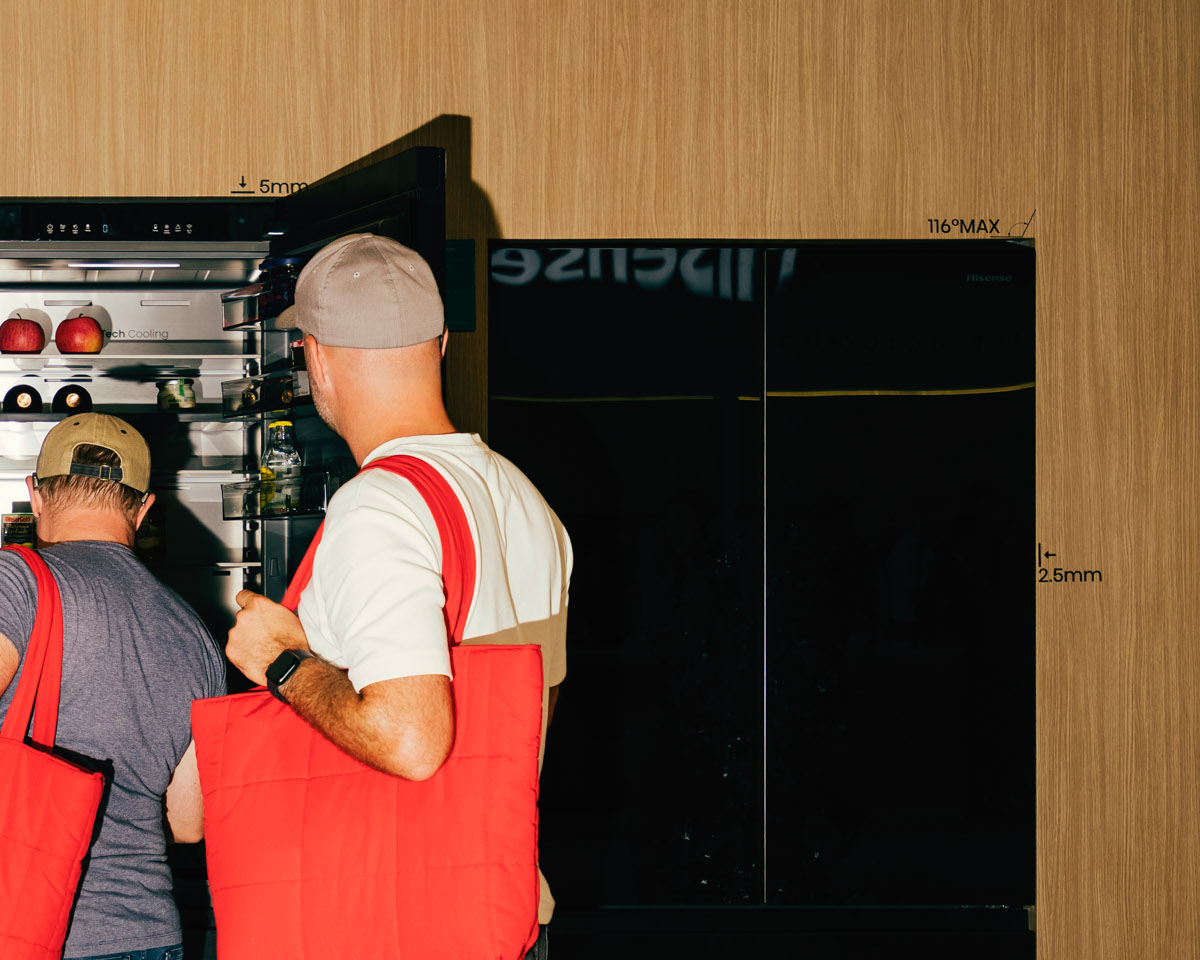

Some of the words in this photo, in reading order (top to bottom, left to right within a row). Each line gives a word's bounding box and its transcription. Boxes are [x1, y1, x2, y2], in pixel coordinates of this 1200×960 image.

[260, 180, 309, 194] 5mm
[966, 274, 1013, 282] Hisense
[128, 330, 168, 340] Cooling
[1038, 568, 1102, 582] 2.5mm
